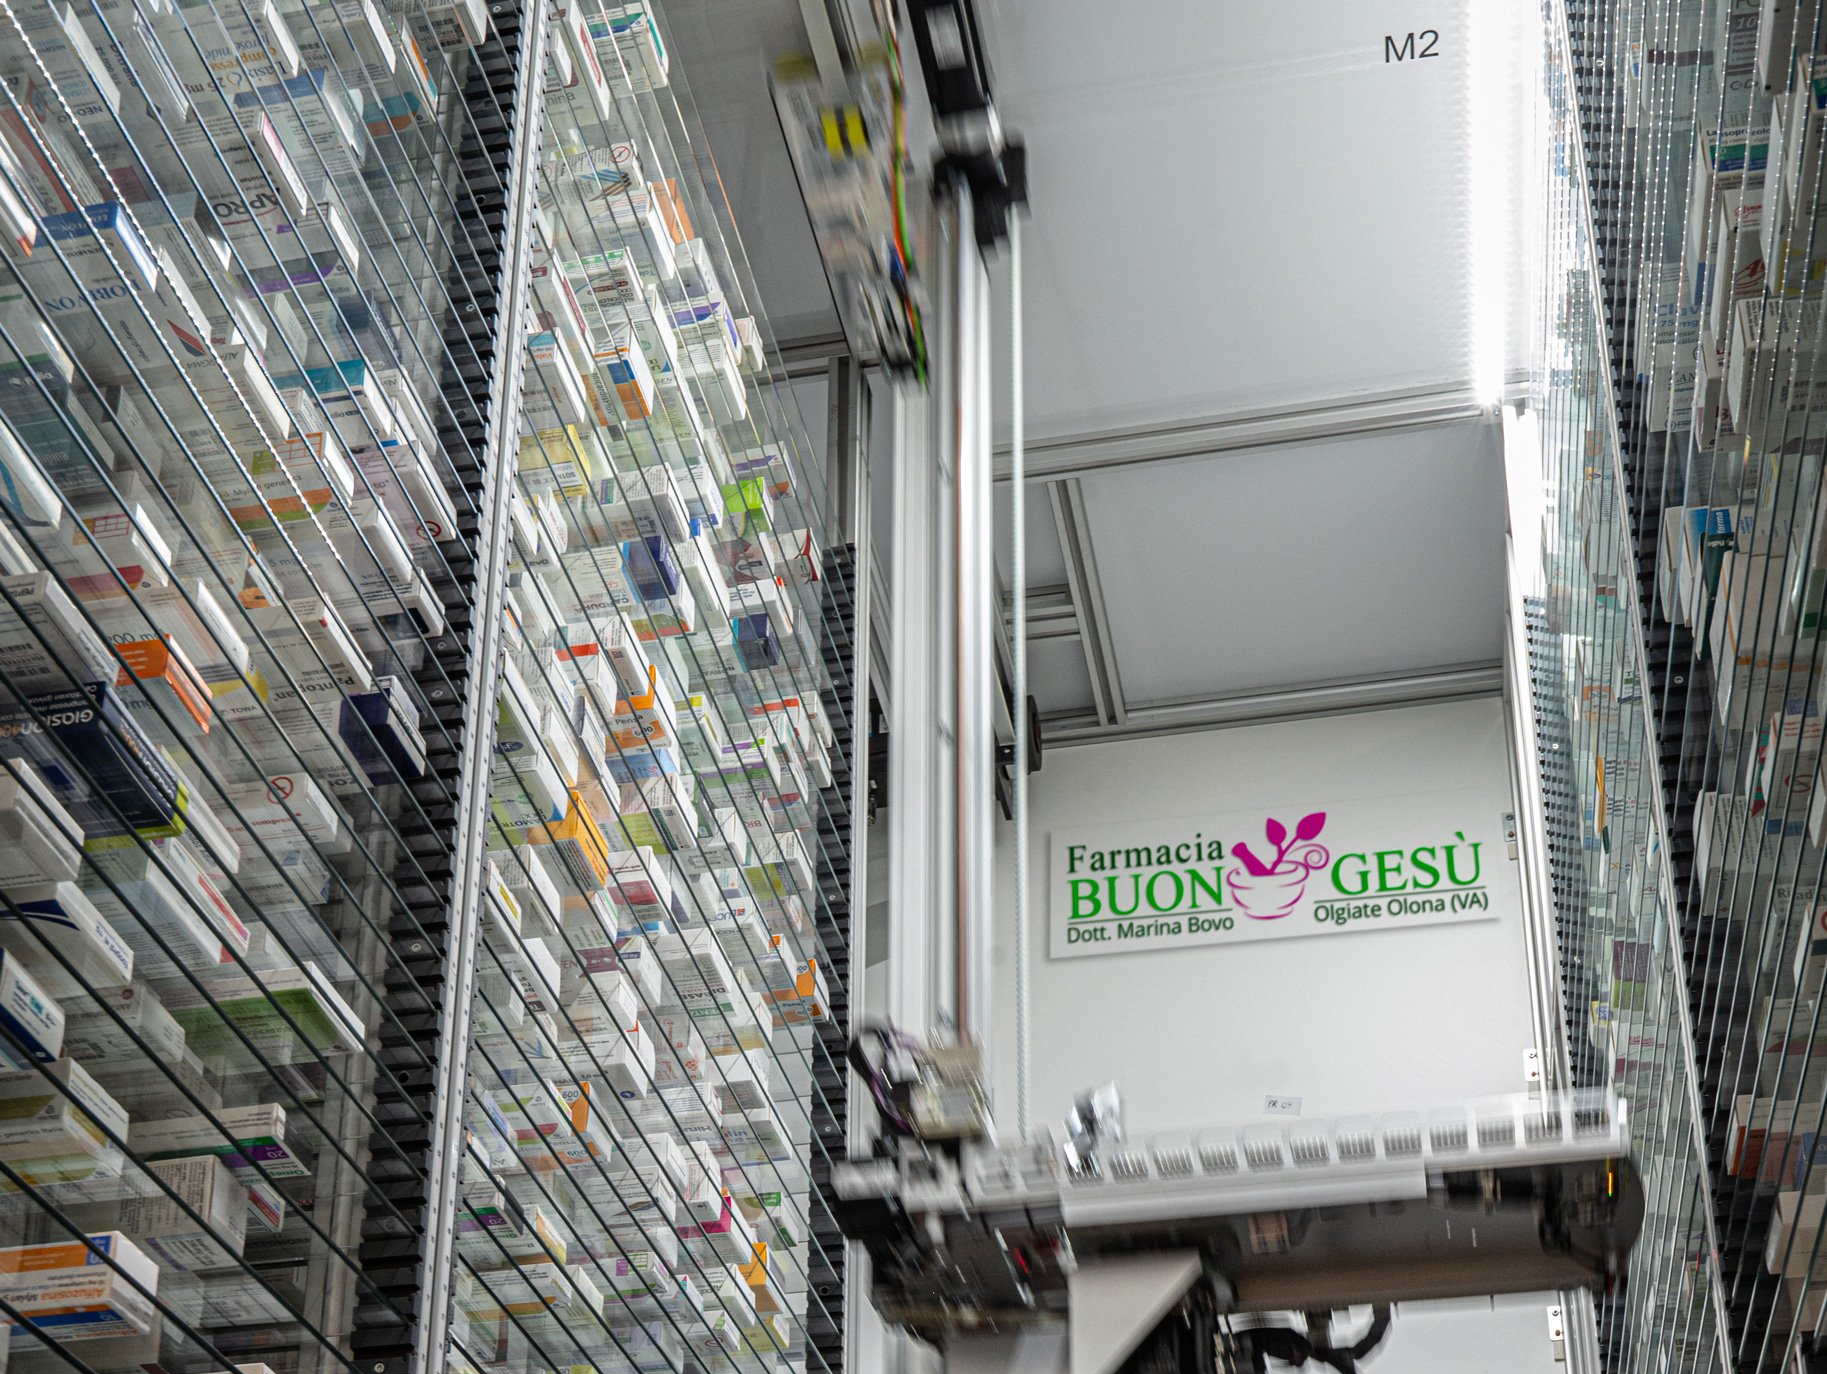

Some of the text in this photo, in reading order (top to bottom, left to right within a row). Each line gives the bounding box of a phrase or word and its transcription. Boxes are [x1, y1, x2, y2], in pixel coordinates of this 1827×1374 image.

[1384, 29, 1440, 64] M2
[1067, 832, 1224, 875] Farmacia
[1066, 831, 1484, 920] BUON GESÙ
[1314, 889, 1489, 927] Olgiate Olona (VA)
[1067, 914, 1235, 944] Dott. Marina Bovo
[266, 1151, 285, 1159] 20
